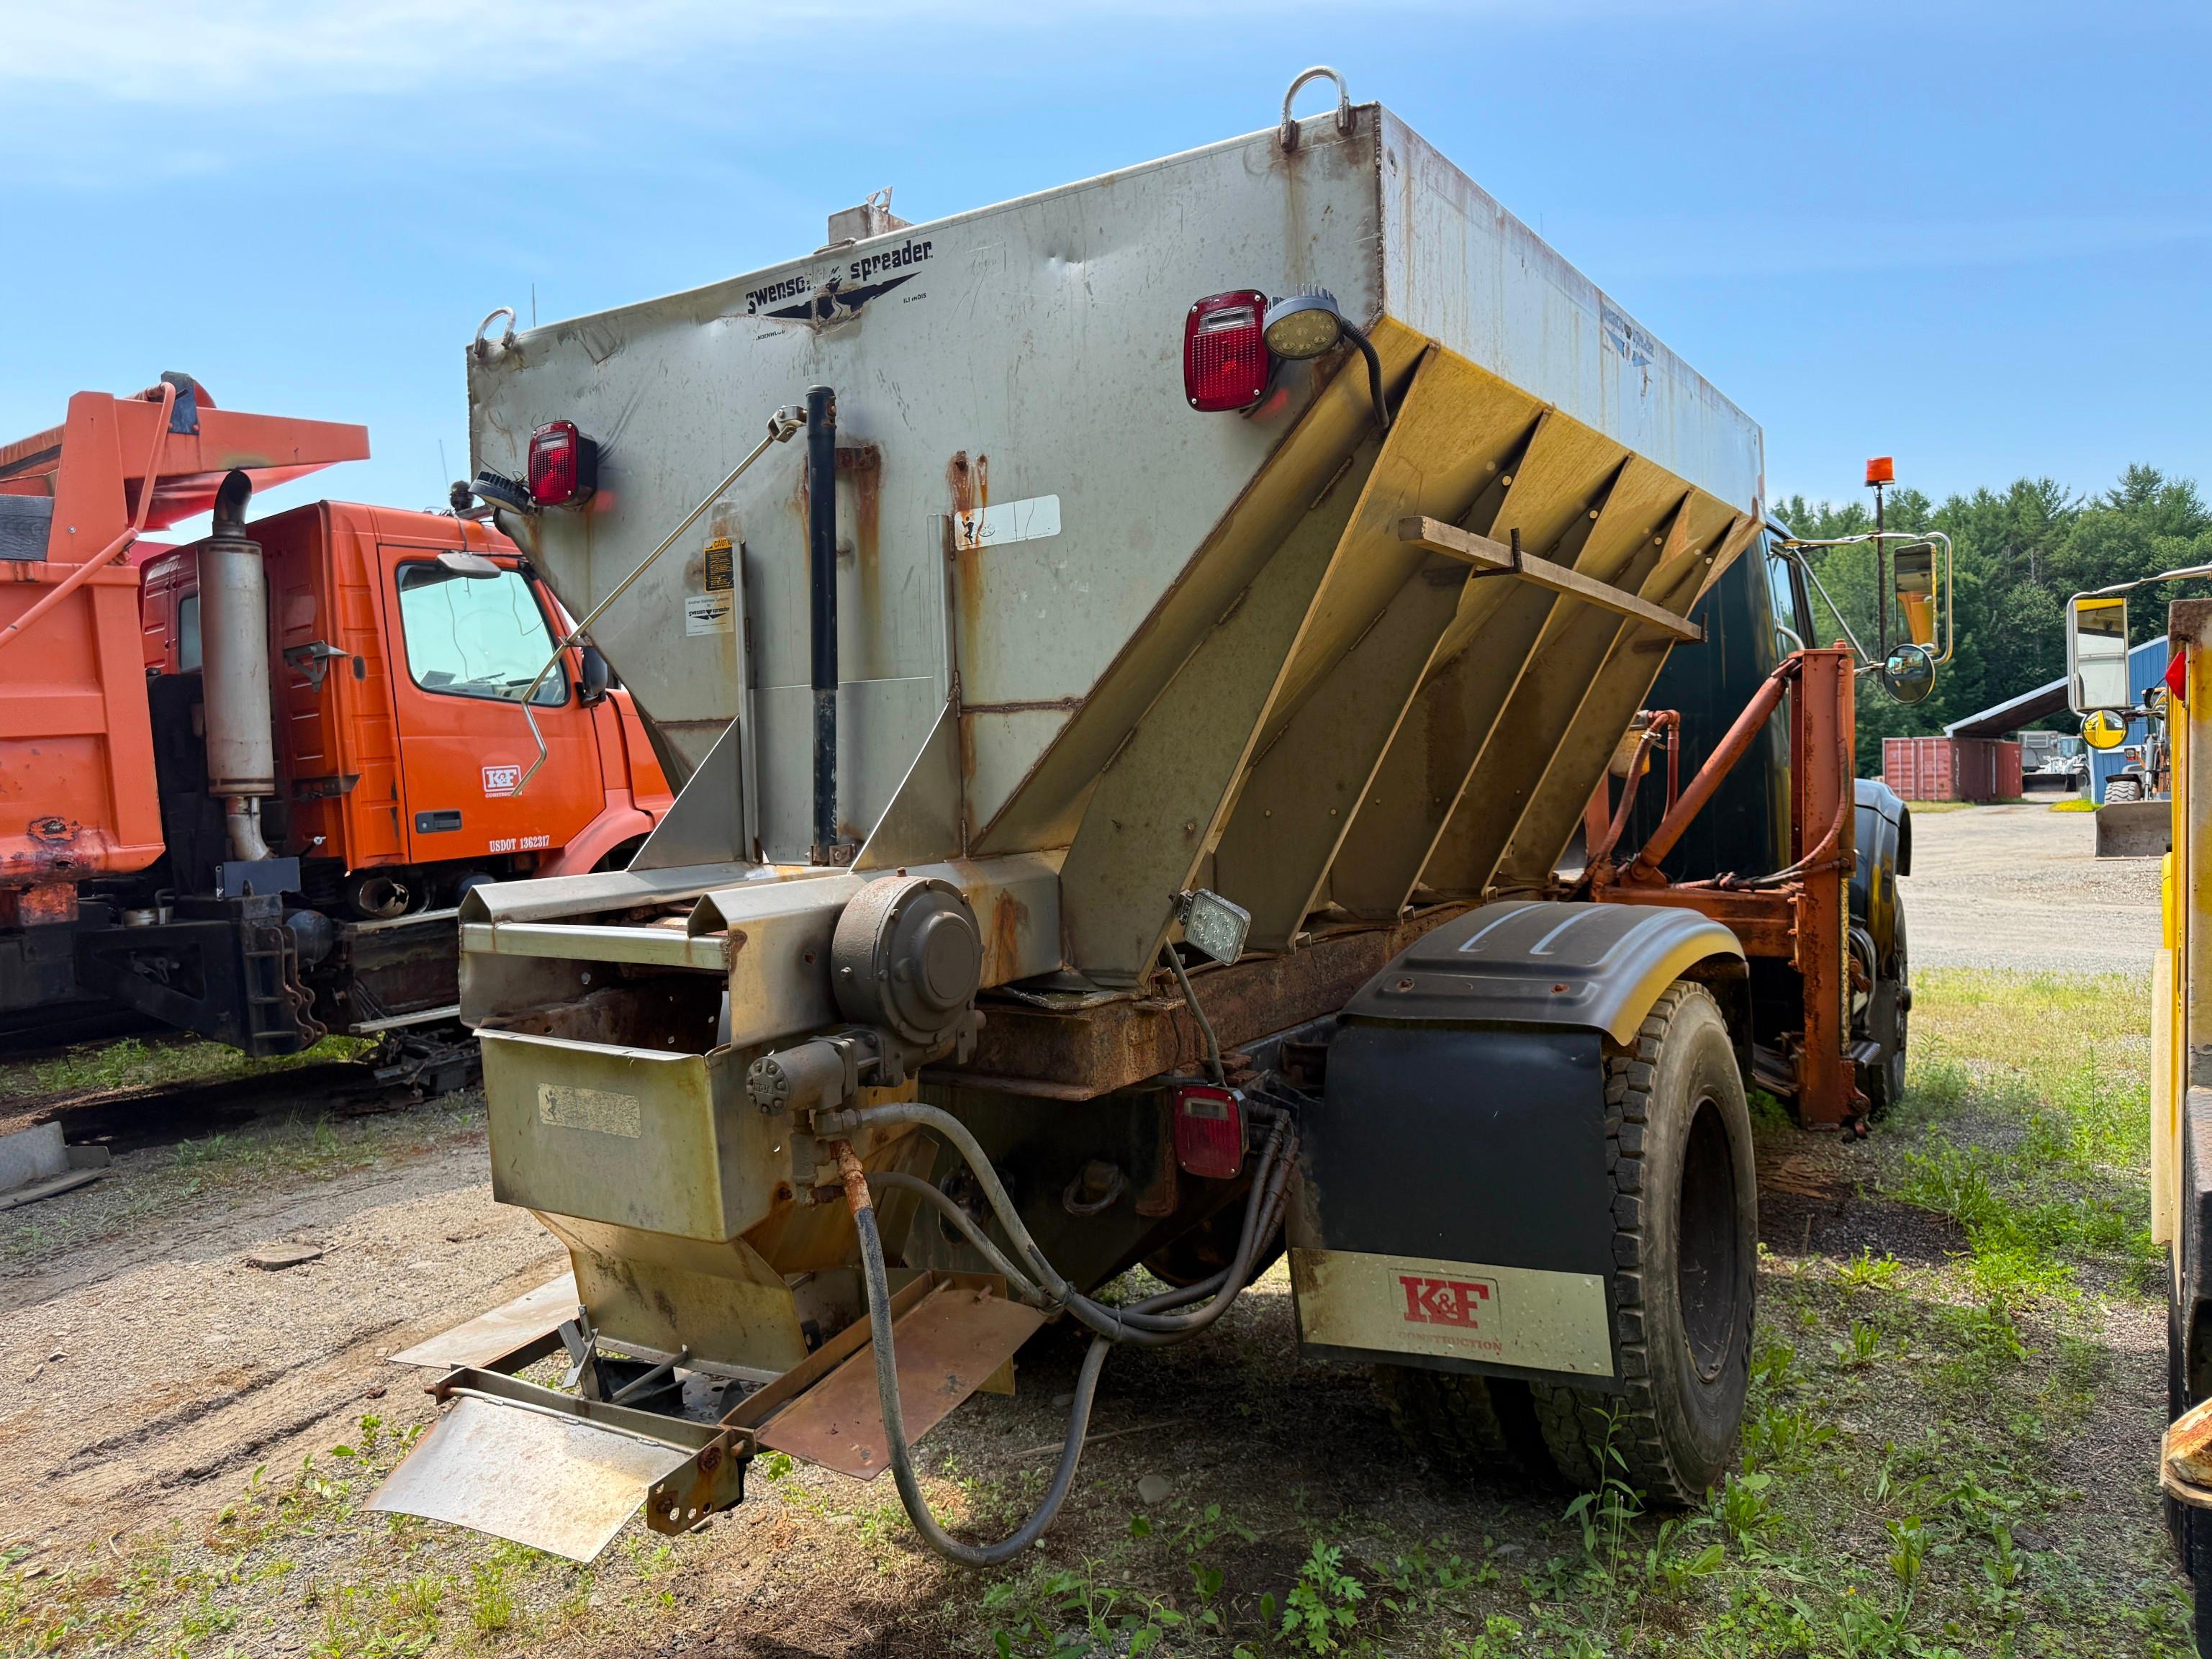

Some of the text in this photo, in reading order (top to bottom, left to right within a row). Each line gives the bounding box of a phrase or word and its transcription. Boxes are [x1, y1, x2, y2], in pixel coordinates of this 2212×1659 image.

[850, 240, 932, 281] spreader
[487, 769, 517, 787] K&F
[490, 835, 550, 852] USDOT 1362317
[1399, 1275, 1490, 1329] K&F
